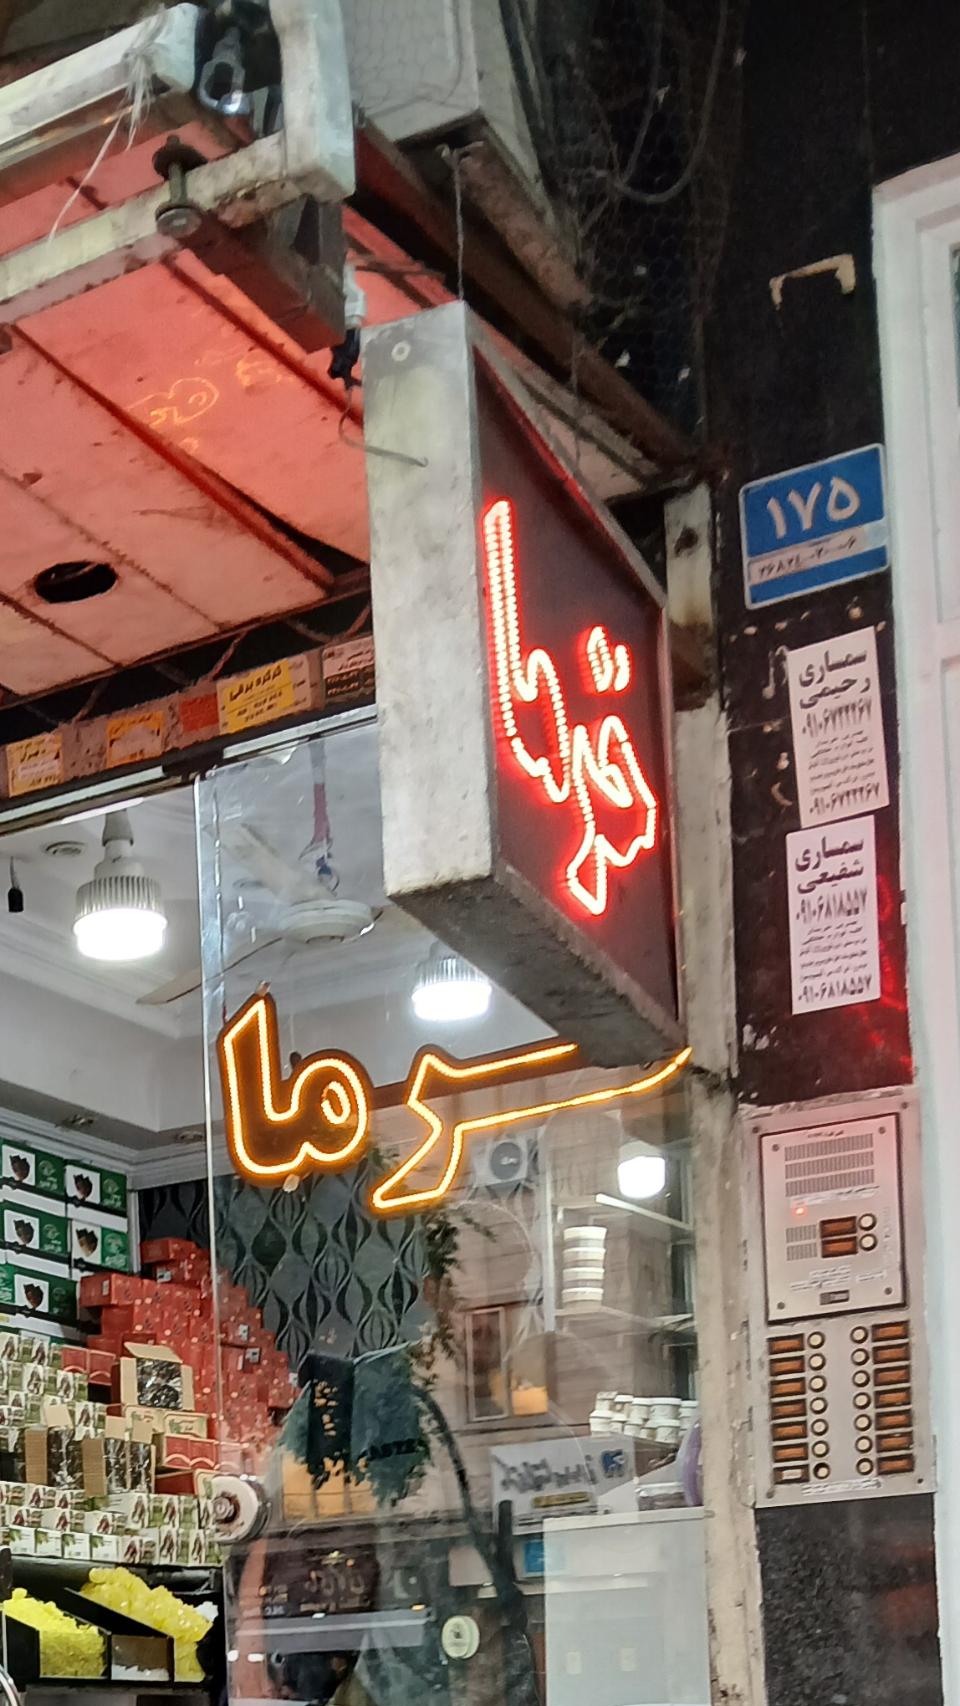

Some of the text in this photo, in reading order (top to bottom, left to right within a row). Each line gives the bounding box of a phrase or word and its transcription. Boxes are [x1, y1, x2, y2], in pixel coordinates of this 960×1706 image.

[766, 475, 861, 540] ۱۷۵
[798, 649, 868, 688] سمساری
[799, 676, 871, 710] رحیمی
[794, 835, 865, 873] سمساری
[797, 858, 865, 894] شفیعی
